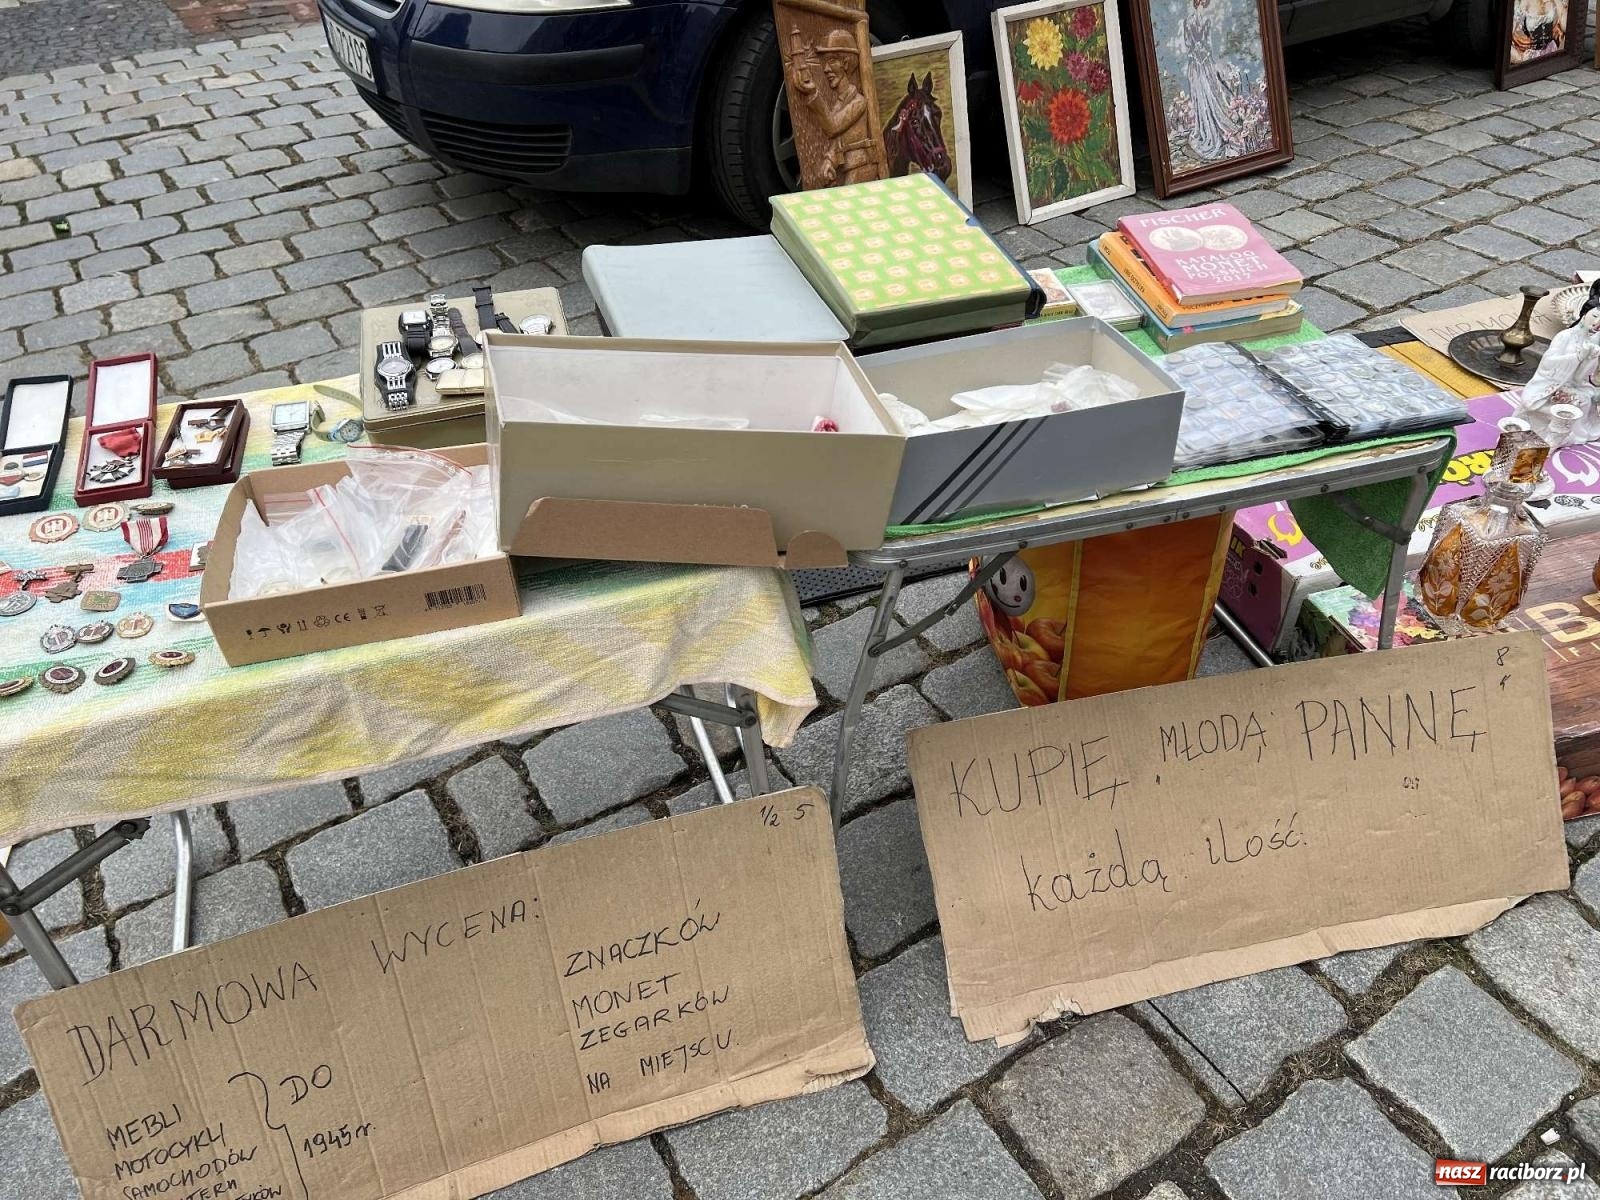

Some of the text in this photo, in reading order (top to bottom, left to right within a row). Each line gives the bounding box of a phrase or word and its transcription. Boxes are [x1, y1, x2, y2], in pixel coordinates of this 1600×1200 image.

[1139, 207, 1227, 228] FISCHER
[1175, 249, 1256, 266] KATALOG
[1181, 255, 1261, 275] MONET
[1187, 263, 1269, 281] POLSKICH
[1215, 272, 1251, 284] 2017
[949, 686, 1488, 818] KUPIĘ MŁODĄ PANNĘ
[562, 899, 721, 979] ZNACZKÓW
[66, 897, 541, 1086] DARMOWA WYCENA:
[572, 972, 683, 1030] MONET
[579, 985, 731, 1052] ZEGARKÓW
[279, 1064, 333, 1105] DO
[587, 1072, 612, 1096] NA
[105, 1103, 183, 1152] MEBLI
